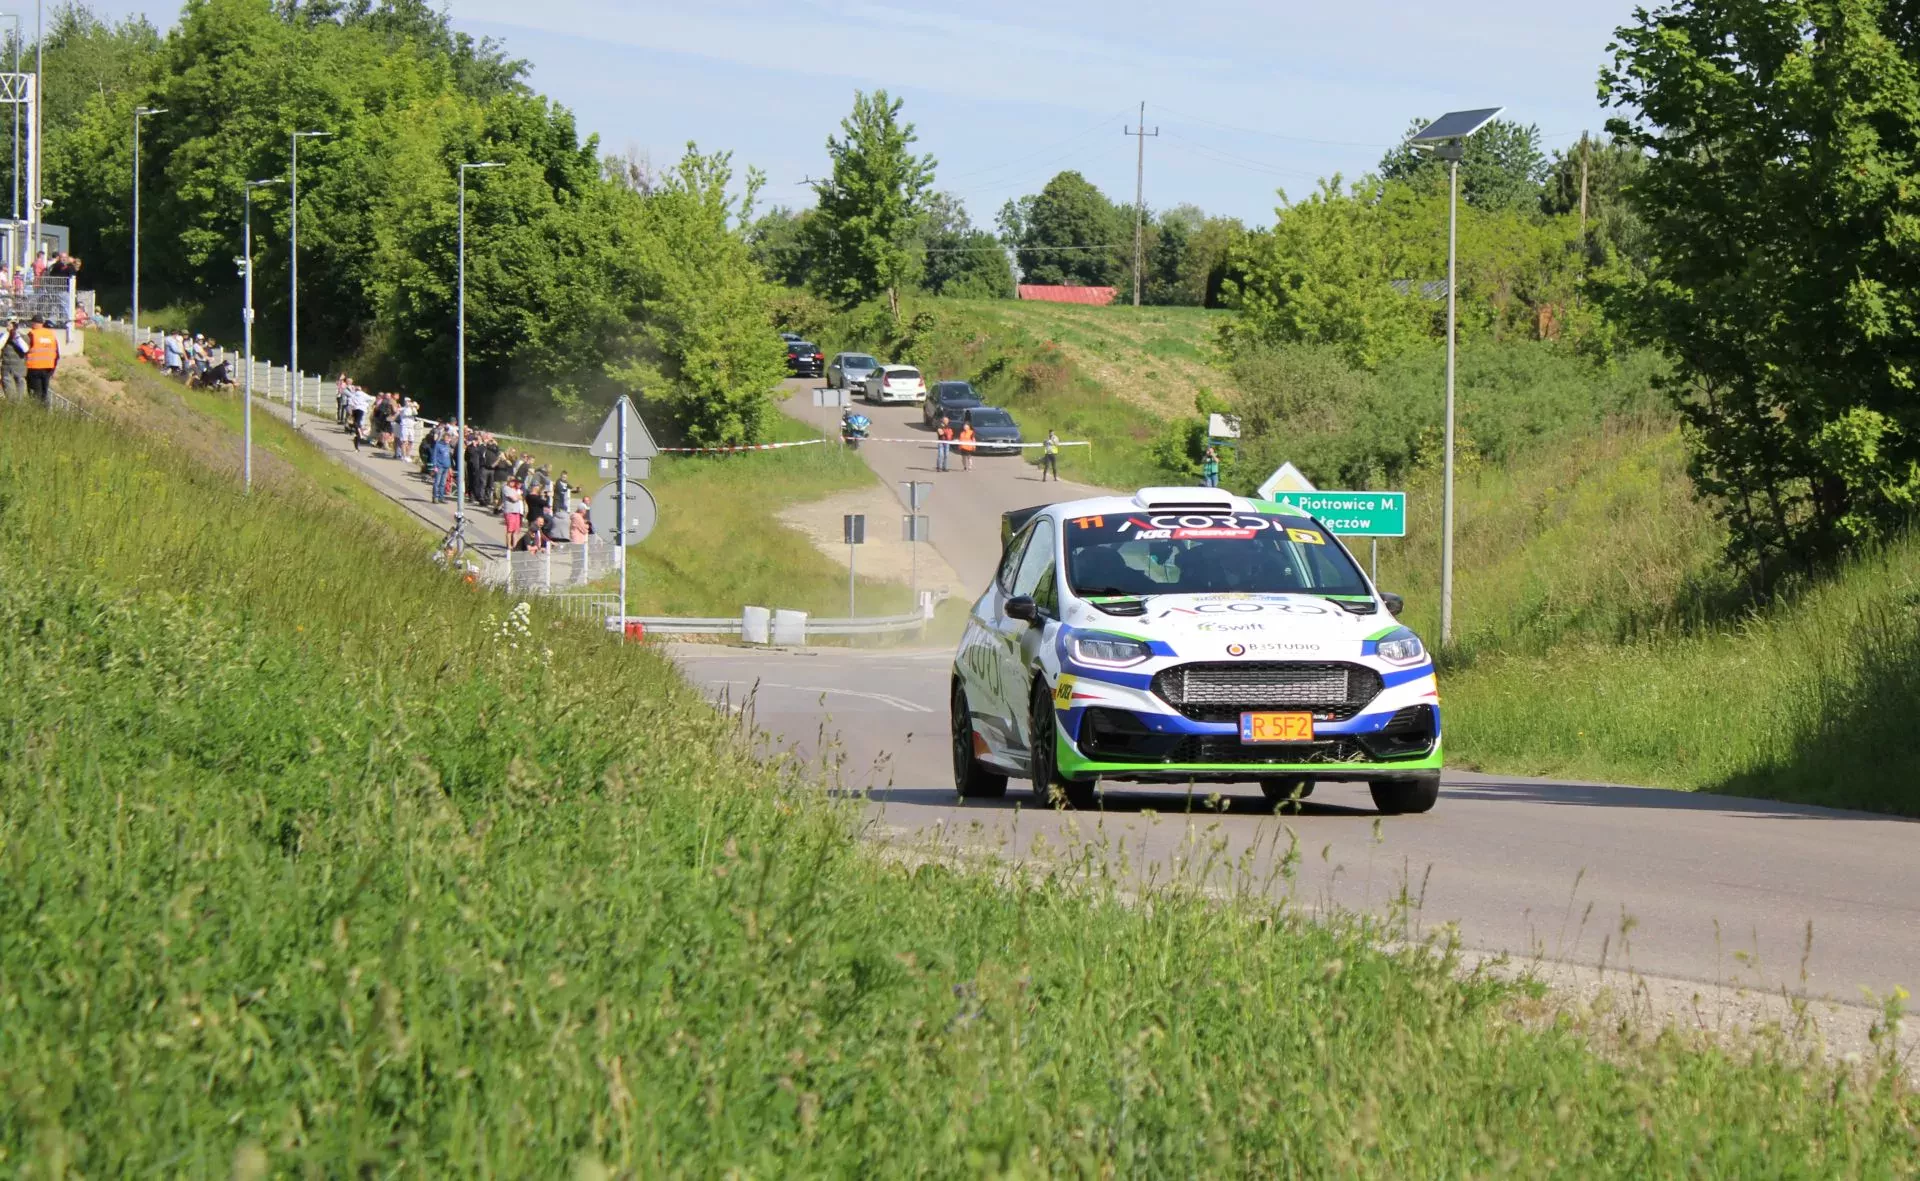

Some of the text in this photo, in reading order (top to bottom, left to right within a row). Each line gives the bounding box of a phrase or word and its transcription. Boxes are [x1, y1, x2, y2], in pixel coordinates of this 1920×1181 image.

[1299, 496, 1399, 511] Piotrowice M.
[1072, 516, 1105, 529] 11
[1253, 716, 1308, 737] R 5F2
